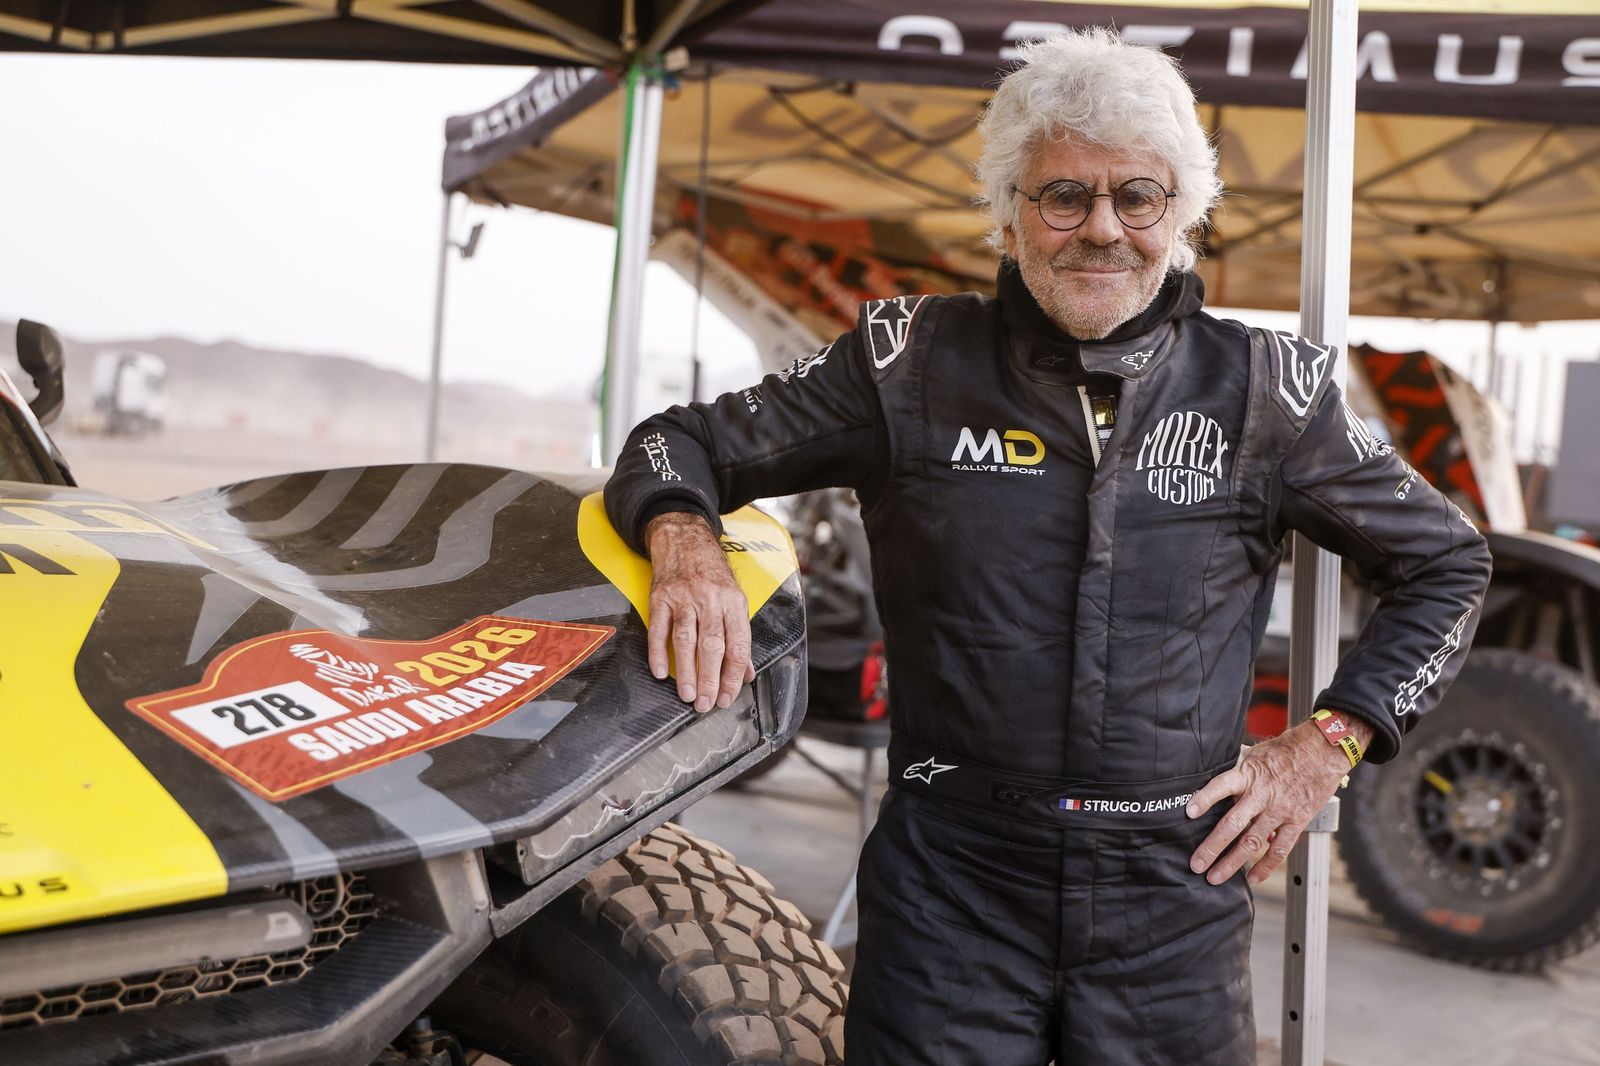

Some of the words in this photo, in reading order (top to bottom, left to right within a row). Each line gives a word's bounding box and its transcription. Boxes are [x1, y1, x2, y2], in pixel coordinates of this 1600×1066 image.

[950, 426, 1046, 466] MD
[1135, 411, 1229, 480] MOREX
[952, 464, 998, 473] RALLYE
[1001, 465, 1046, 476] SPORT
[1147, 467, 1216, 506] CUSTOM
[394, 626, 538, 687] 2026
[211, 692, 317, 737] 278
[287, 706, 424, 762] SAUDI
[404, 660, 546, 725] ARABIA
[1083, 799, 1142, 813] STRUGO
